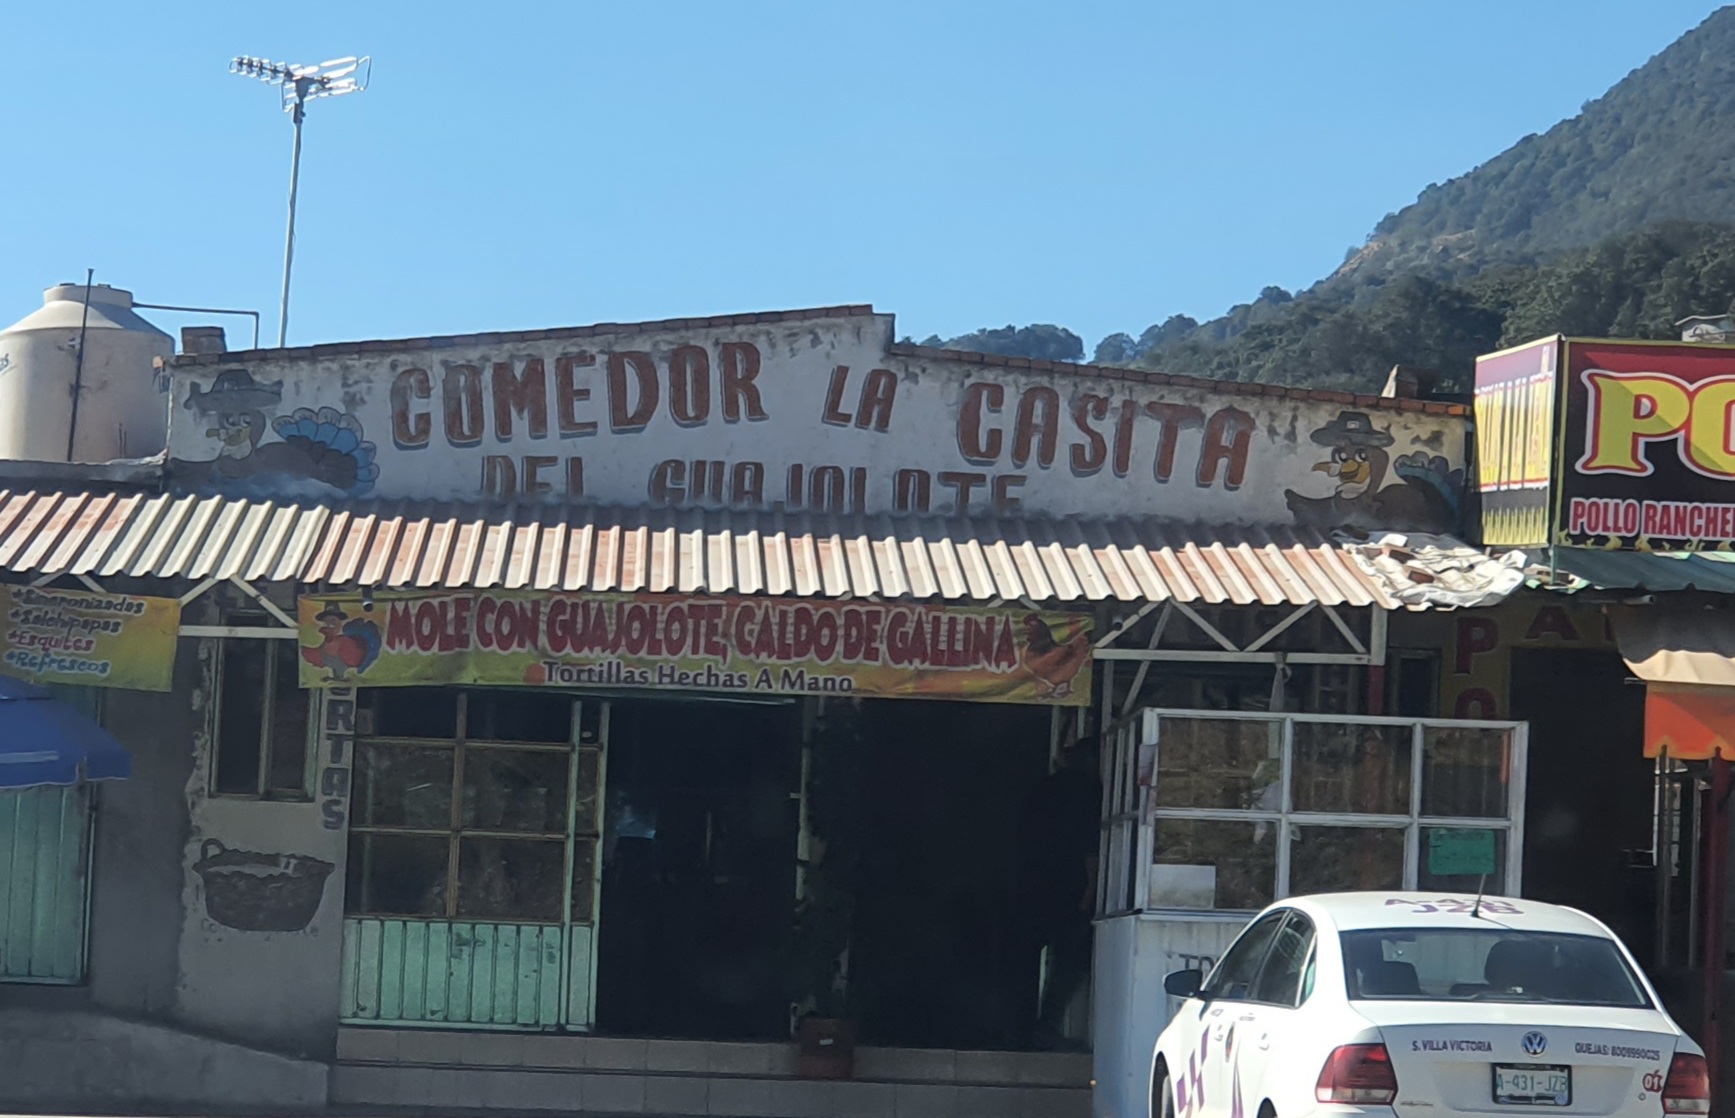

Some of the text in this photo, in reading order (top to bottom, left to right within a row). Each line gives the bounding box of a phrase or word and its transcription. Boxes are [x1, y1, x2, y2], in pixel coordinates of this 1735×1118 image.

[390, 341, 1254, 490] COMEDOR LA CASITA
[1570, 500, 1640, 536] POLLO
[386, 598, 1017, 668] MOLE CON GUAJOLOTE, CALDO DE GALLINA
[543, 660, 853, 693] Tortillas Hechas A Mano
[1421, 1040, 1448, 1052] VILLA
[1448, 1041, 1493, 1052] VICTORIA
